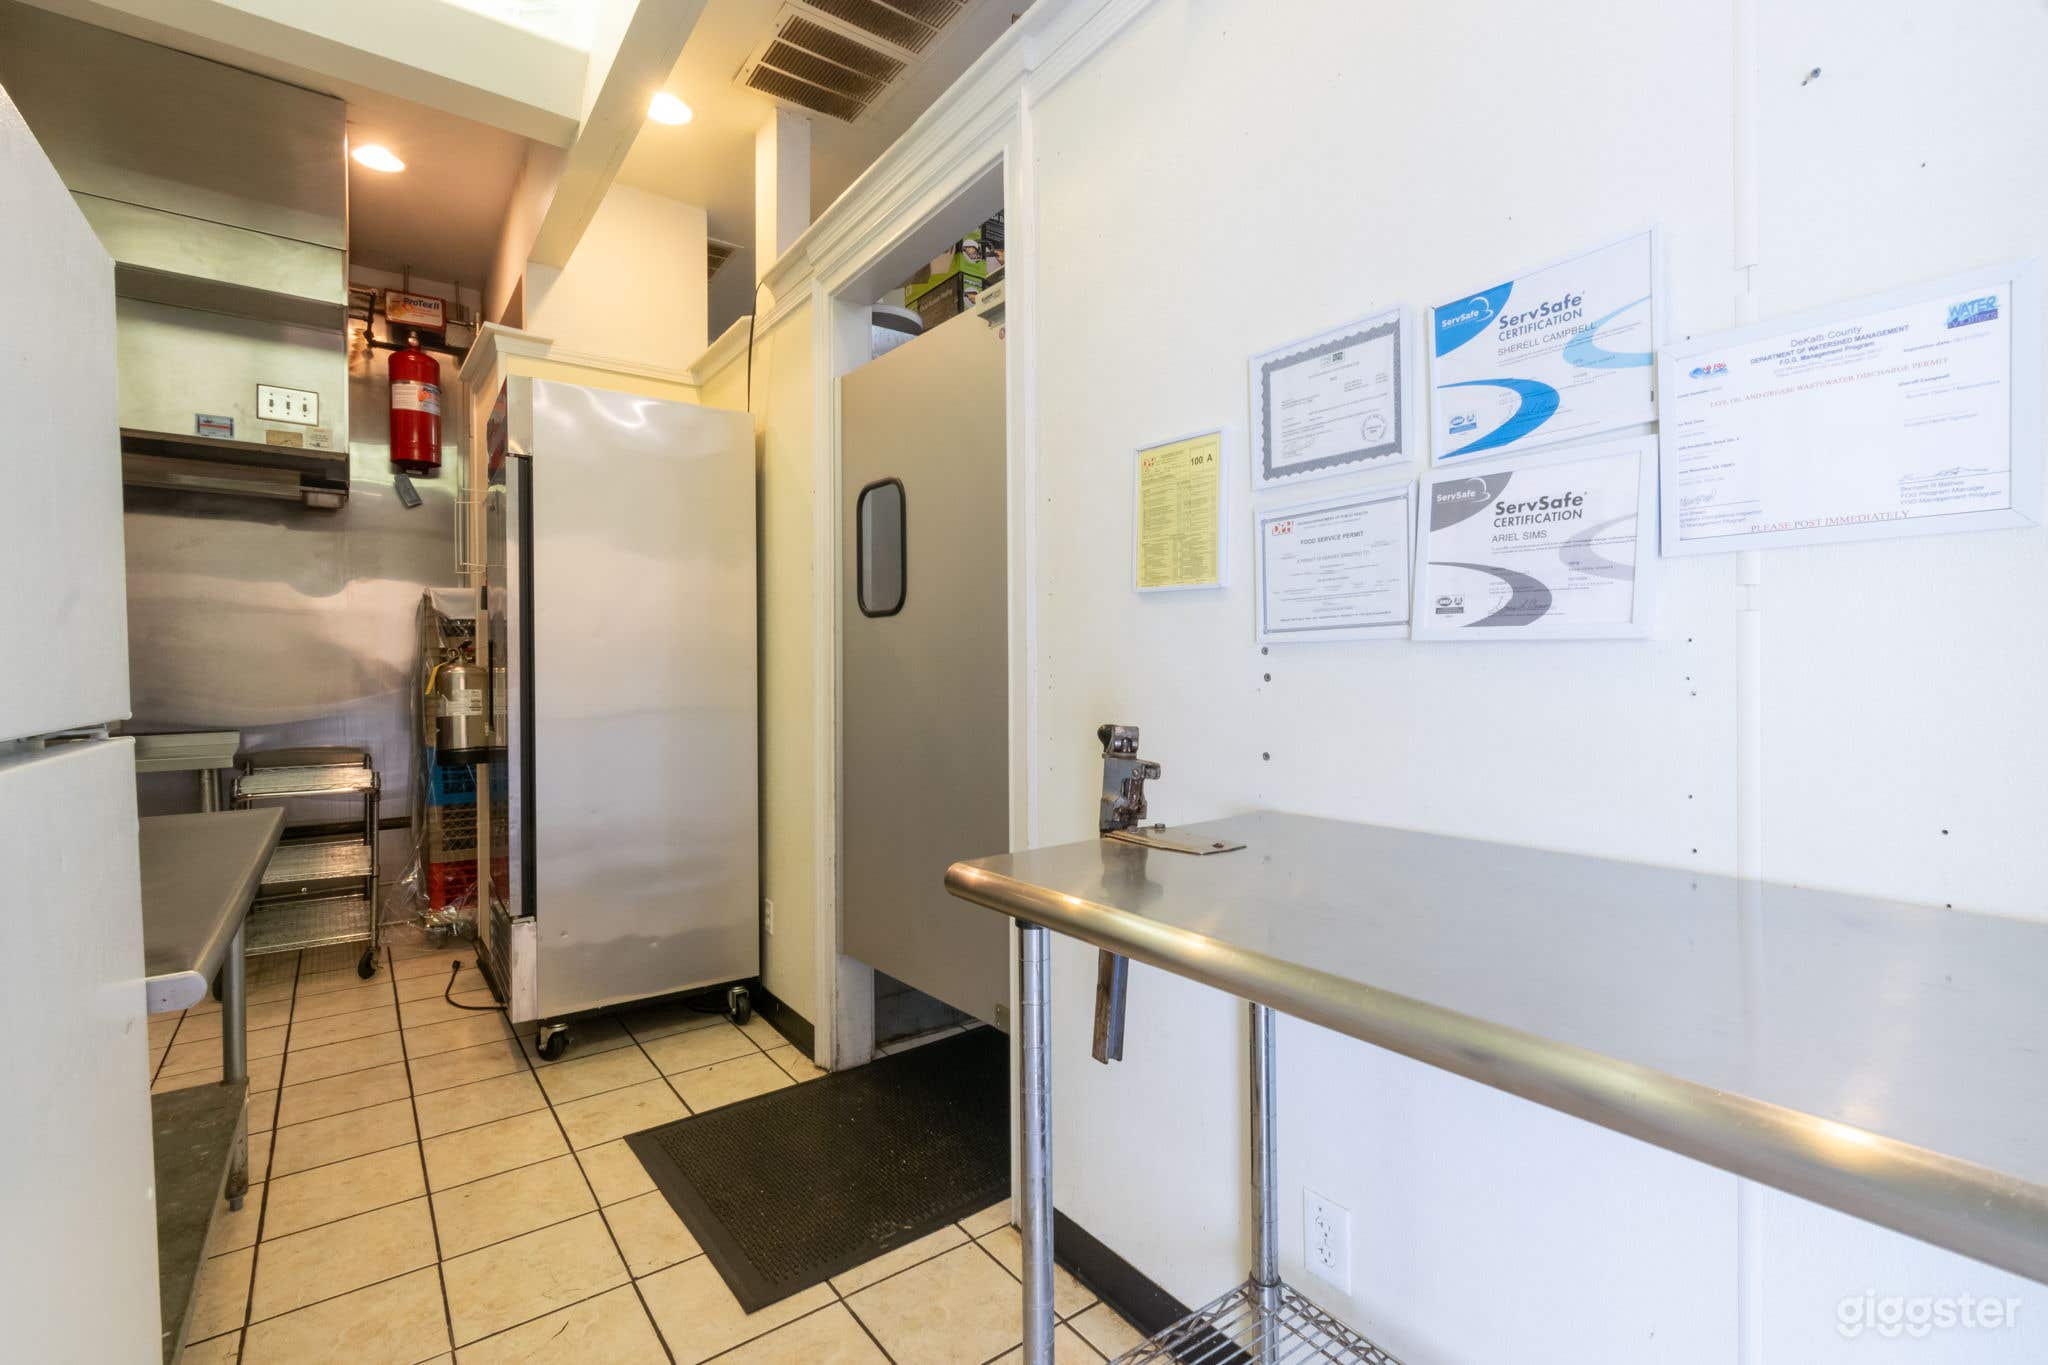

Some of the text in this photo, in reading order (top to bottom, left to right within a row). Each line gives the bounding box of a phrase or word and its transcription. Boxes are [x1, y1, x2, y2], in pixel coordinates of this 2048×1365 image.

[1499, 293, 1583, 330] ServSafe
[1948, 295, 1999, 319] WATER
[1442, 310, 1479, 328] ServSafe
[1498, 308, 1583, 342] CERTIFICATION
[1497, 337, 1540, 357] SHERELL
[1542, 323, 1596, 346] CAMPBELL
[1750, 347, 1796, 365] DEPARTMENT
[1853, 324, 1910, 342] MANAGEMENT
[1790, 326, 1863, 348] DeKalb County
[1191, 455, 1204, 466] 100
[1437, 490, 1476, 503] ServSafe
[1495, 491, 1584, 516] ServSafe
[1493, 509, 1583, 528] CERTIFICATION
[1750, 520, 1792, 533] PLEASE
[1794, 516, 1823, 530] POST
[1825, 510, 1910, 527] IMMEDIATELY
[1300, 530, 1364, 545] FOOD SERVICE PERMIT
[1491, 529, 1548, 544] ARIEL SIMS
